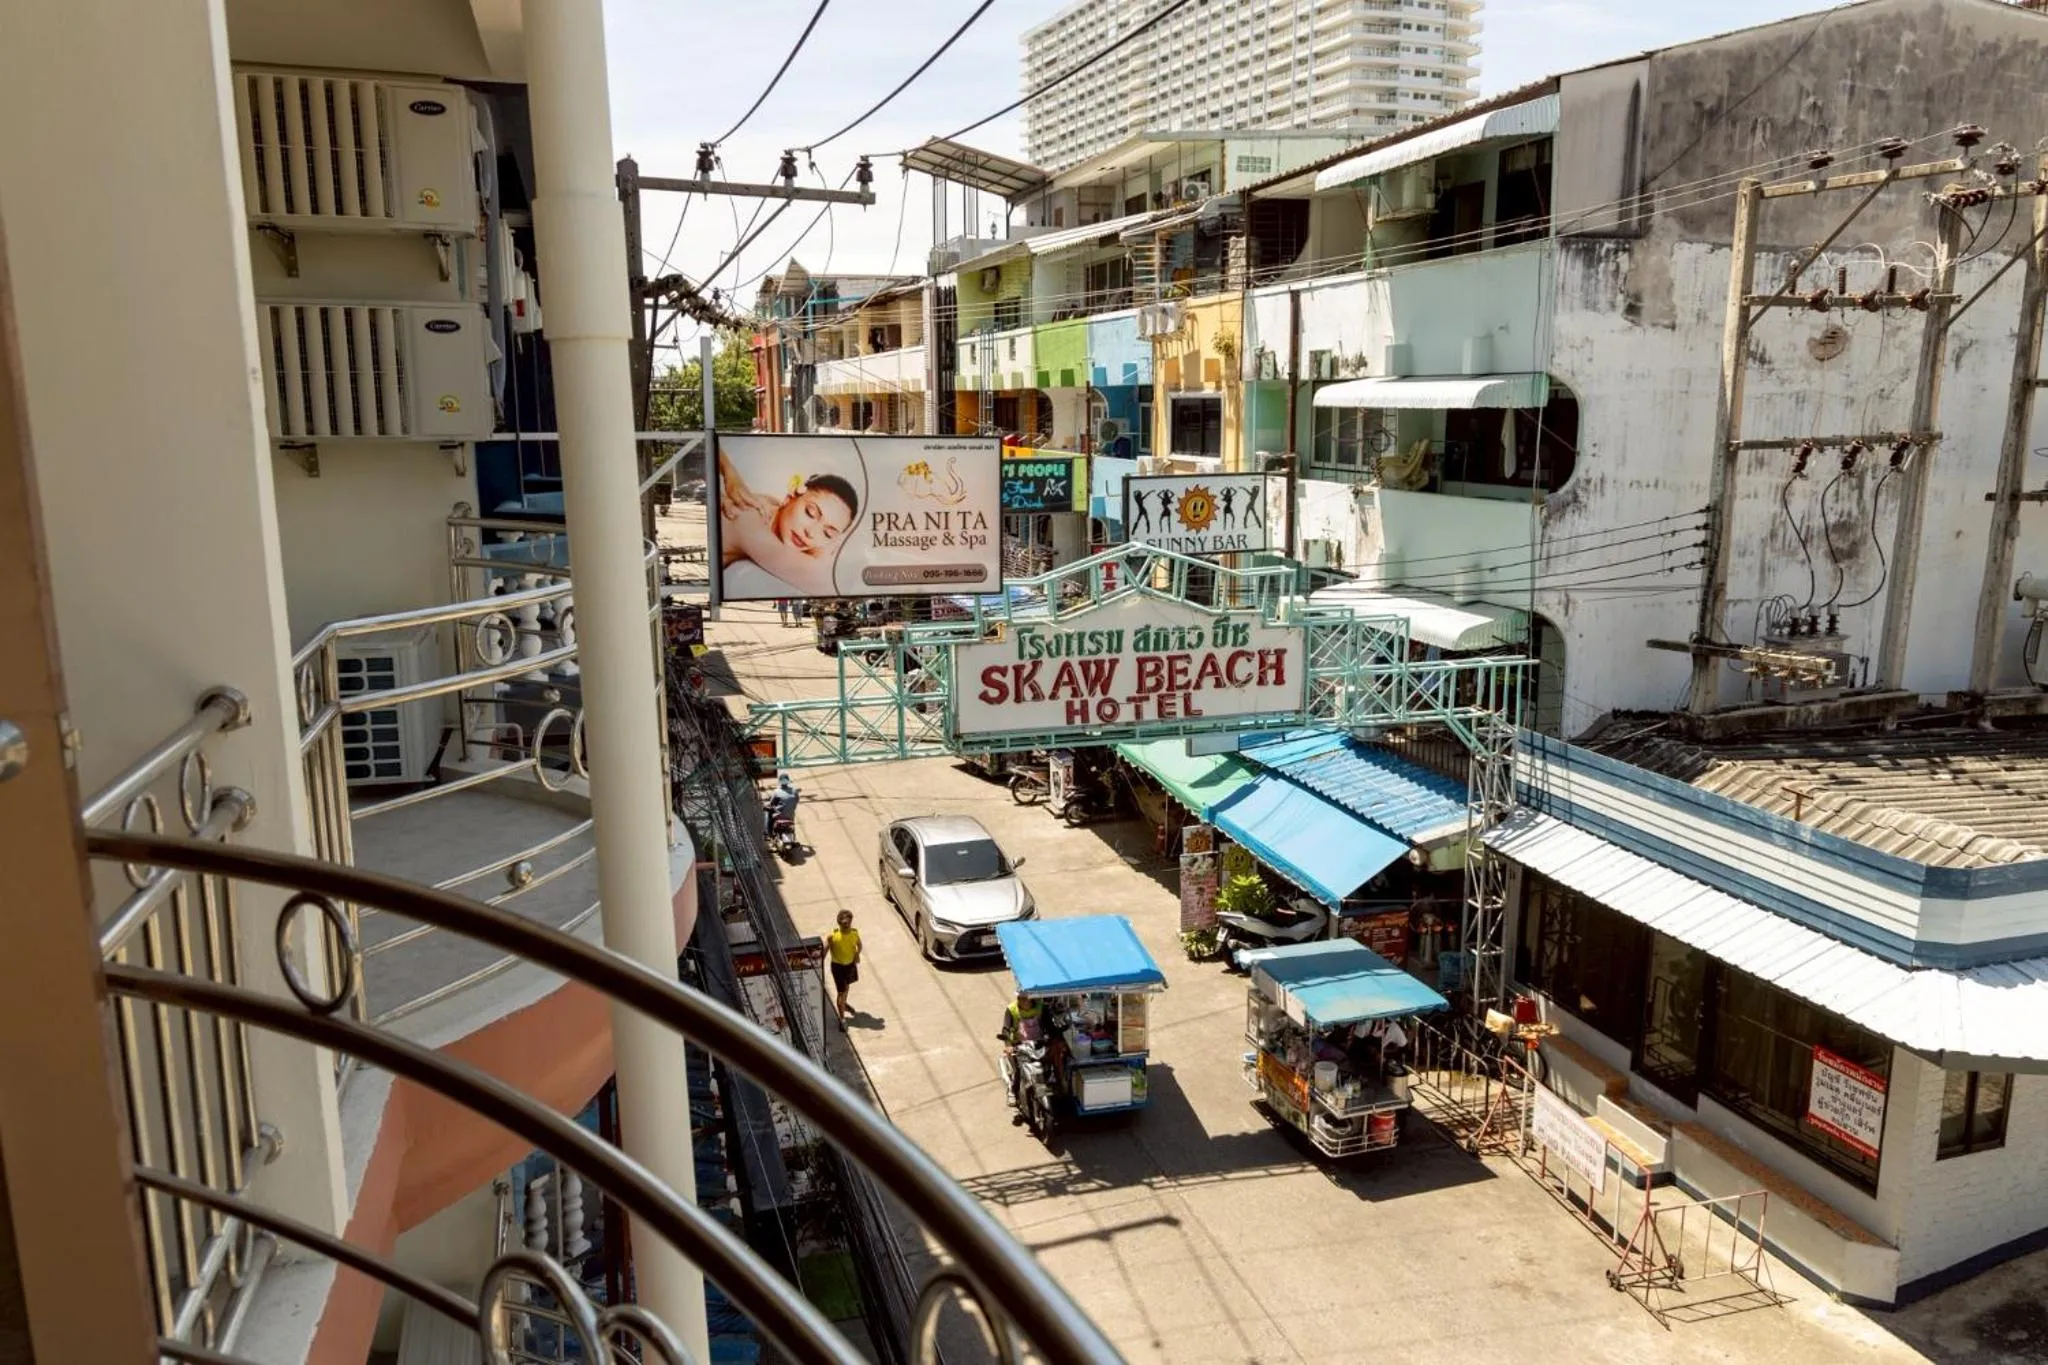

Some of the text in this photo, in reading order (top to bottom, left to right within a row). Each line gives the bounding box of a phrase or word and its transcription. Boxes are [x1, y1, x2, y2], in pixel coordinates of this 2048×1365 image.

[1018, 463, 1066, 477] PEOPLE
[872, 530, 987, 551] Massage & Spa
[1212, 534, 1249, 550] BAR
[1016, 626, 1125, 660] โรงแรม
[1133, 626, 1204, 653] สกาว
[978, 648, 1288, 705] SKAW BEACH
[1065, 692, 1203, 725] HOTEL
